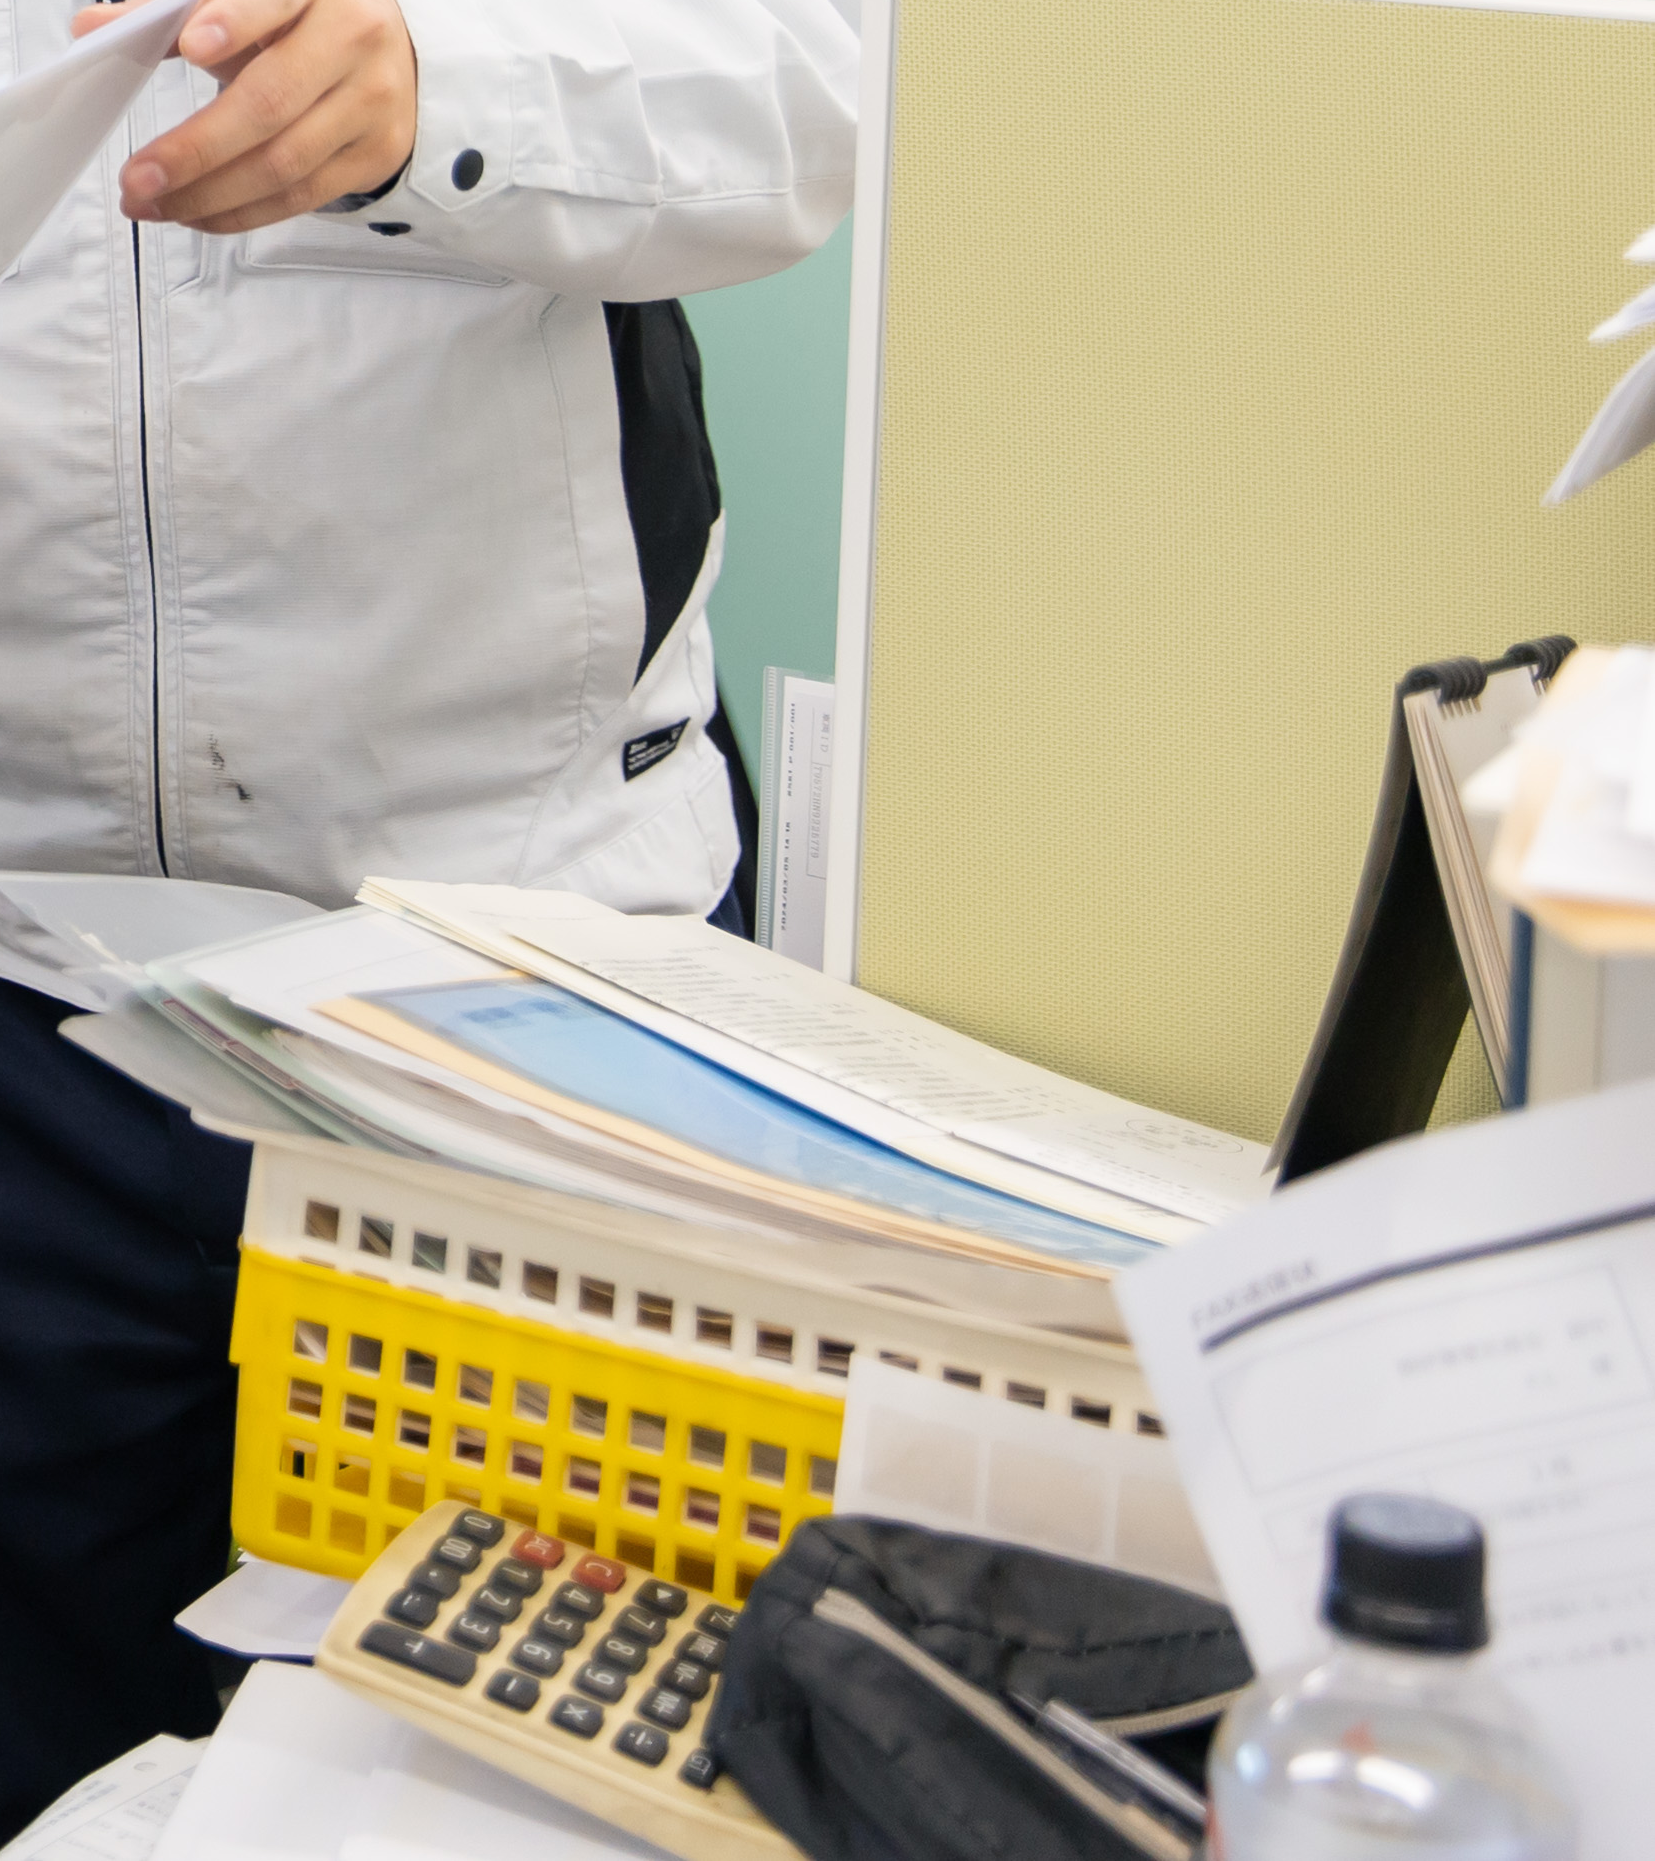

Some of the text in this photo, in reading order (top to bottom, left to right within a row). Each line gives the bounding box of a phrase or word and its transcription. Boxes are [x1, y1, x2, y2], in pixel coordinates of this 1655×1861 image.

[502, 1566, 530, 1579] 1
[480, 1589, 511, 1606] 2
[563, 1588, 591, 1605] 4
[459, 1617, 490, 1635] 3
[543, 1613, 573, 1631] 5
[627, 1613, 657, 1630] 7
[522, 1643, 552, 1660] 6
[606, 1640, 636, 1656] 8
[585, 1668, 616, 1686] 9
